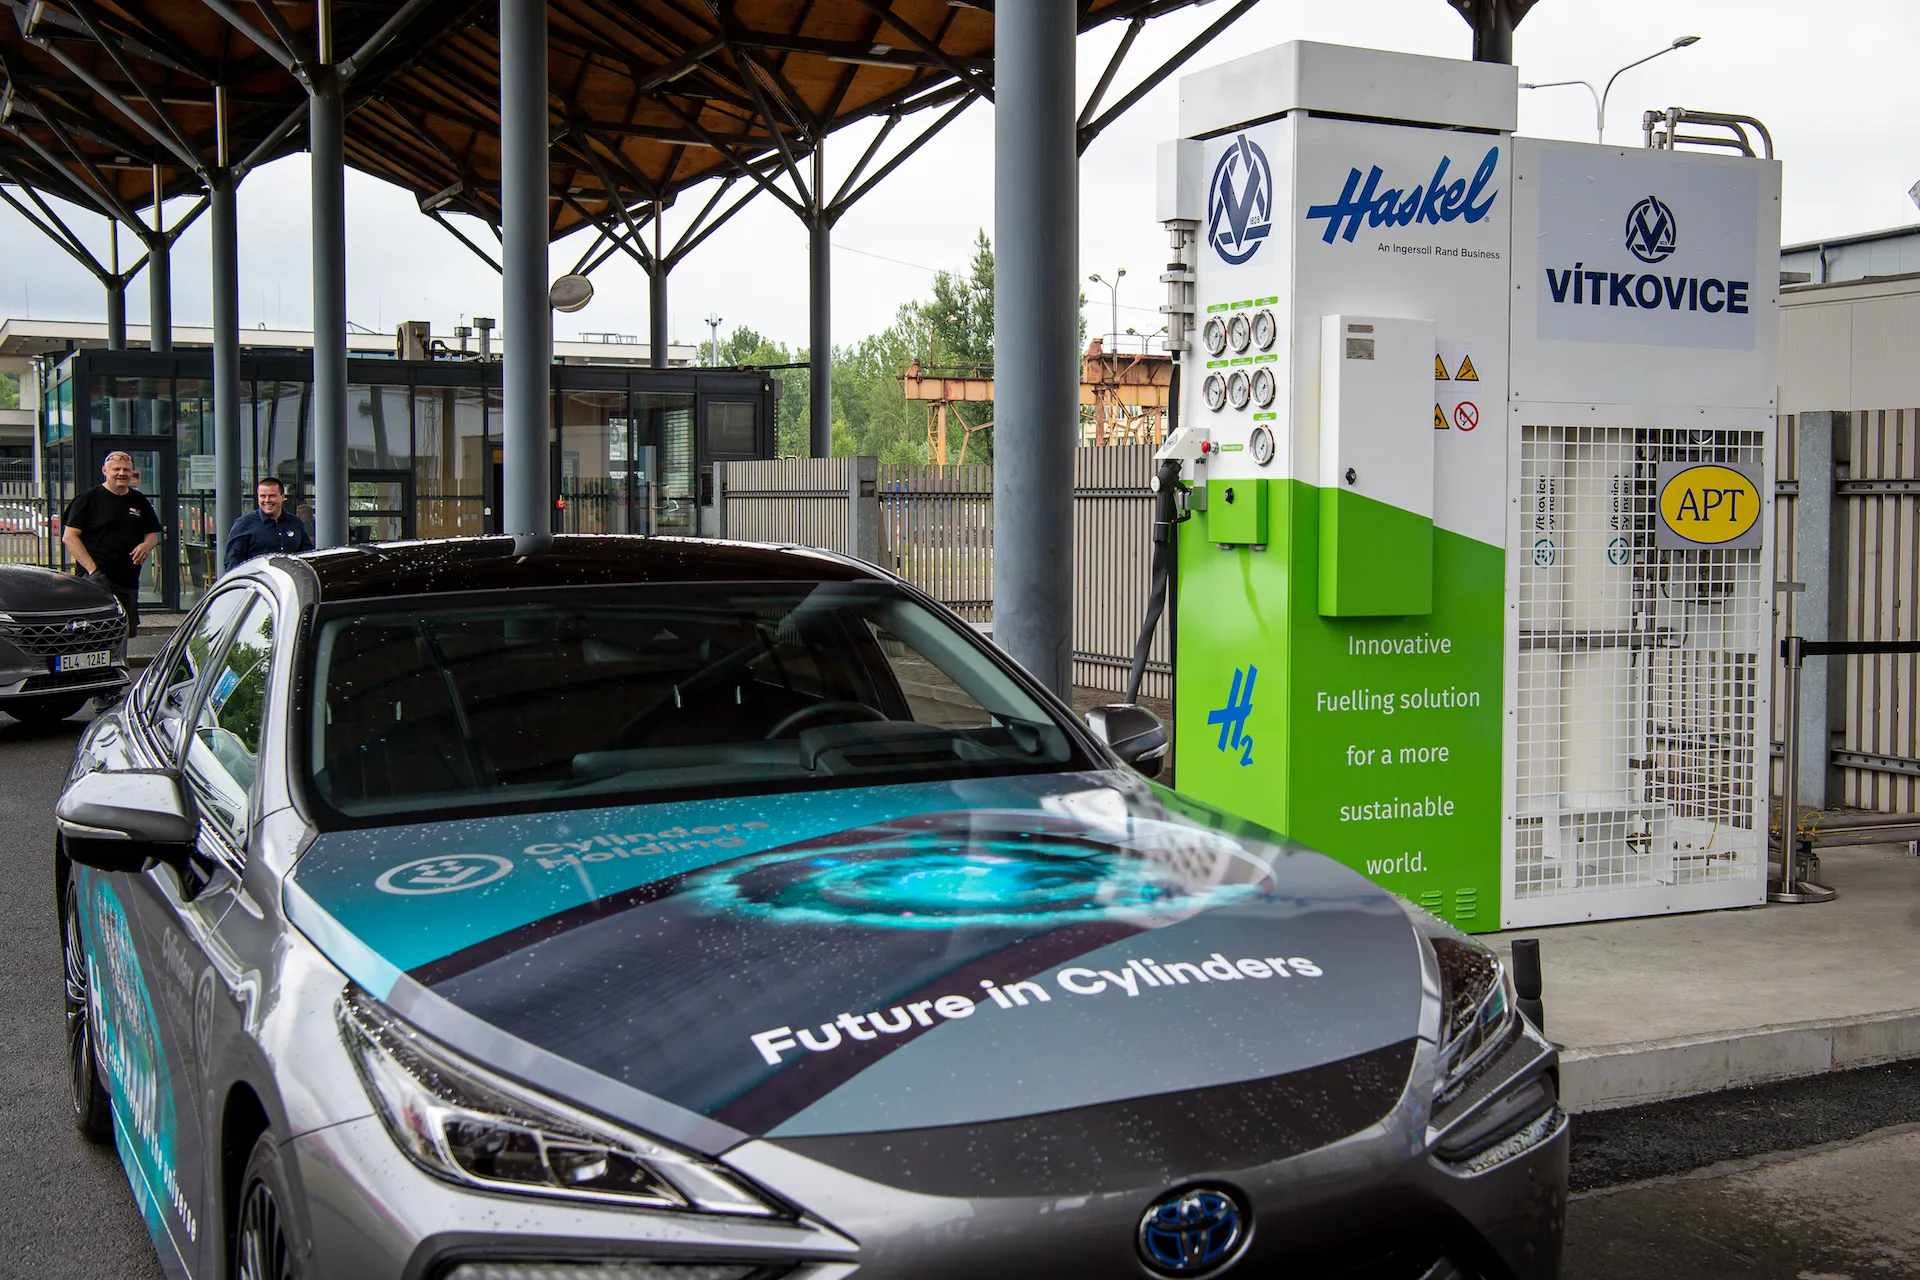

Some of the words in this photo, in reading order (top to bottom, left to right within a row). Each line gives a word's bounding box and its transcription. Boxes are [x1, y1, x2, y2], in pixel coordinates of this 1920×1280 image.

[1377, 243, 1390, 252] An
[1393, 243, 1432, 255] Ingersoll
[1435, 246, 1458, 257] Rand
[1461, 248, 1500, 259] Business
[1545, 262, 1750, 314] VÍTKOVICE
[1675, 488, 1745, 522] APT
[1348, 633, 1452, 656] Innovative
[62, 656, 80, 669] EL4
[86, 652, 107, 667] 12AE
[1316, 690, 1395, 714] Fuelling
[1400, 686, 1480, 710] solution
[1346, 744, 1375, 767] for
[1380, 749, 1392, 765] a
[1399, 745, 1449, 764] more
[1339, 796, 1455, 822] sustainable
[523, 821, 769, 856] Cylinders
[536, 835, 746, 869] Holding
[1366, 851, 1428, 876] world.
[750, 993, 976, 1066] Future
[980, 978, 1051, 1010] in
[1056, 951, 1324, 998] Cylinders
[151, 1130, 163, 1171] the
[163, 1160, 197, 1243] universe
